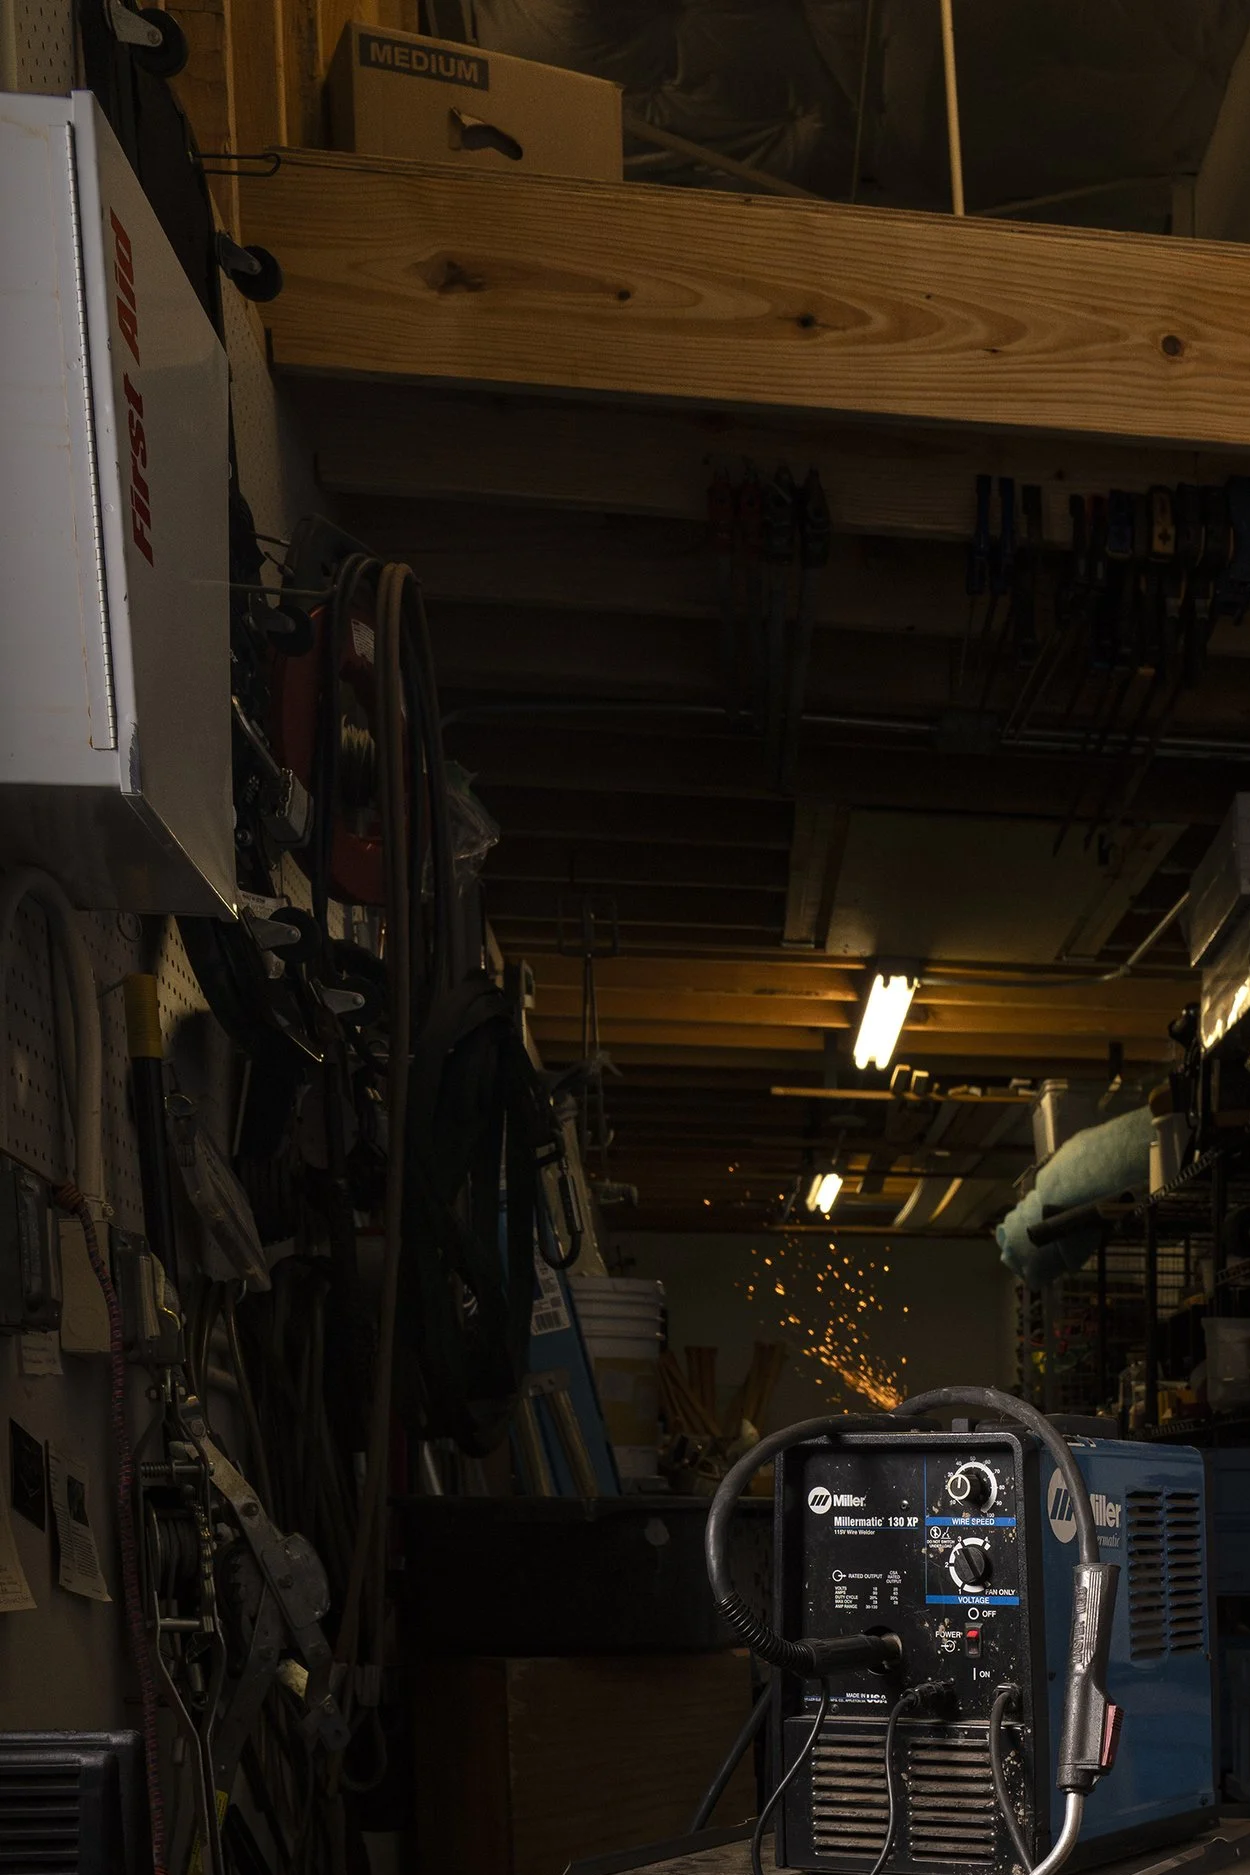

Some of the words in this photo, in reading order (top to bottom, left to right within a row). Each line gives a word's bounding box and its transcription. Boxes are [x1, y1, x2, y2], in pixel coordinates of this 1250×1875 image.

[370, 41, 479, 83] MEDIUM
[109, 206, 141, 367] Aid
[122, 372, 154, 568] First
[833, 1495, 866, 1508] Miller
[834, 1517, 883, 1528] Millermatic
[887, 1518, 905, 1528] 130
[907, 1518, 919, 1528] XP
[952, 1517, 971, 1526] WIRE
[973, 1517, 995, 1526] SPEED
[958, 1596, 990, 1604] VOLTAGE
[982, 1610, 997, 1618] OFF
[935, 1631, 961, 1639] POWER
